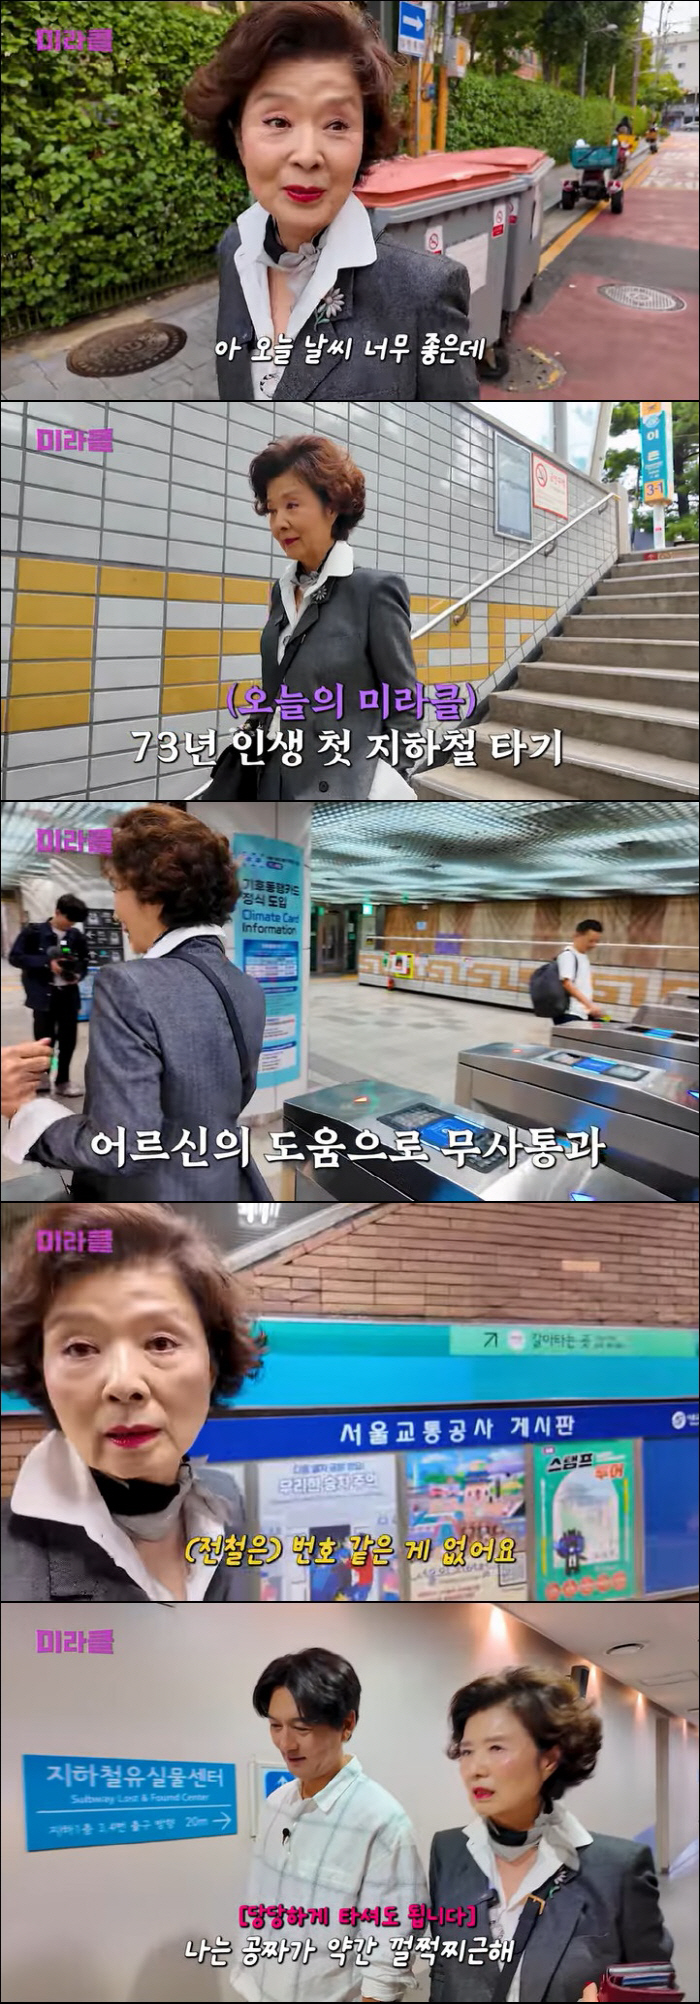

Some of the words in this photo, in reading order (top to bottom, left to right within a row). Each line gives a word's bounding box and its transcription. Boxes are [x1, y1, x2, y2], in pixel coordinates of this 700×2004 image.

[646, 482, 663, 496] 3-1
[268, 895, 287, 909] 도입
[242, 922, 296, 935] Information
[340, 1419, 494, 1446] 서울교통공사
[510, 1413, 576, 1438] 게시판
[547, 1452, 593, 1473] 스탬프
[46, 1763, 224, 1788] 지하철유실물센터
[70, 1793, 114, 1805] Subway
[118, 1794, 139, 1803] Lost
[151, 1793, 180, 1801] Found
[181, 1792, 209, 1801] Center
[185, 1816, 208, 1827] 20m
